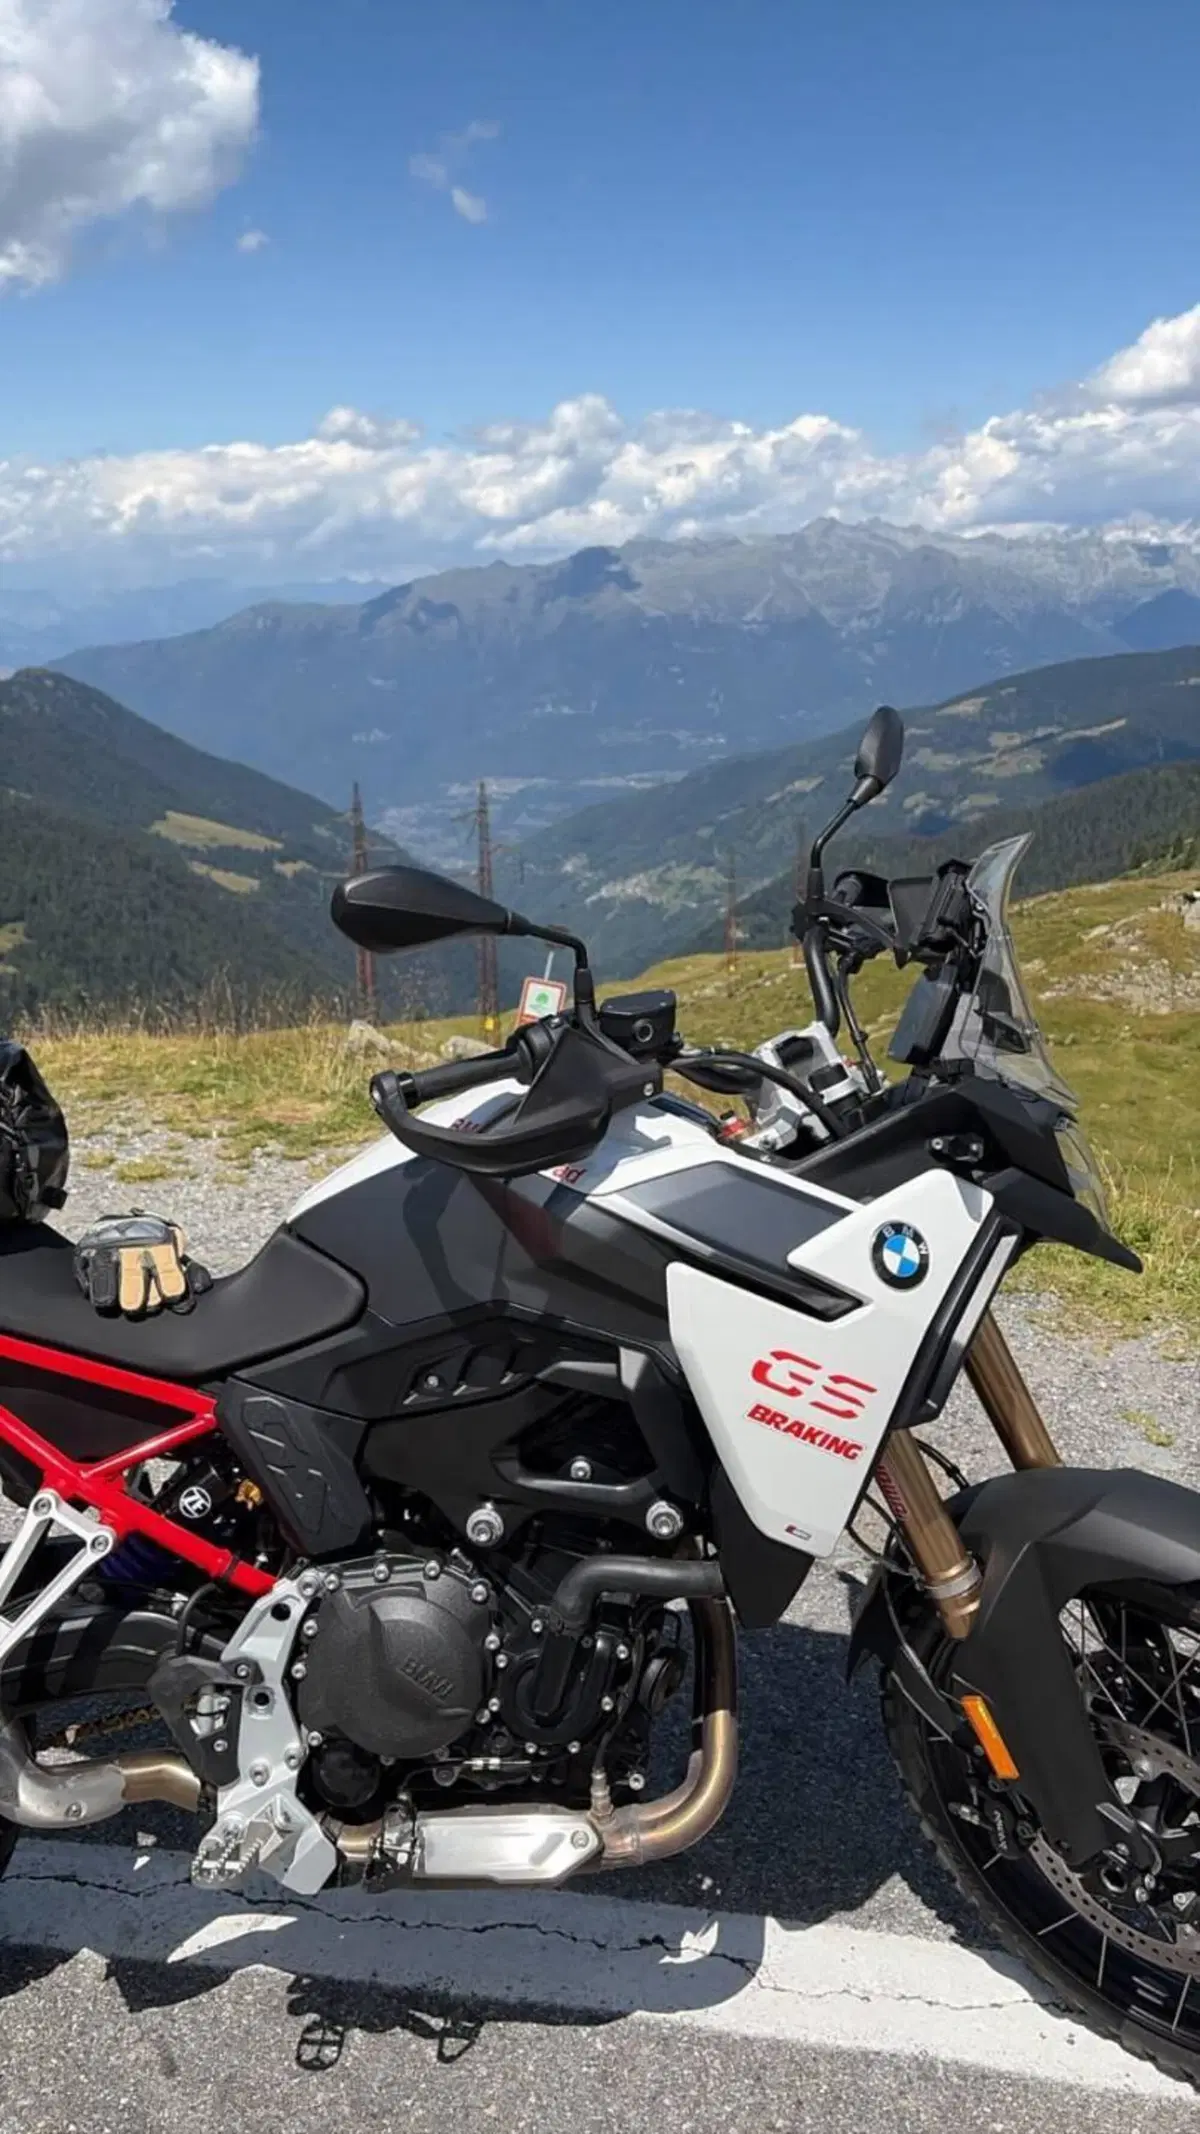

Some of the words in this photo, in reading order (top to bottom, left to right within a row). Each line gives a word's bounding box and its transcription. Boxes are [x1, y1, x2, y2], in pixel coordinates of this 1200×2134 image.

[882, 1222, 930, 1255] BMW
[751, 1349, 878, 1420] GS
[746, 1403, 864, 1460] BRAKING
